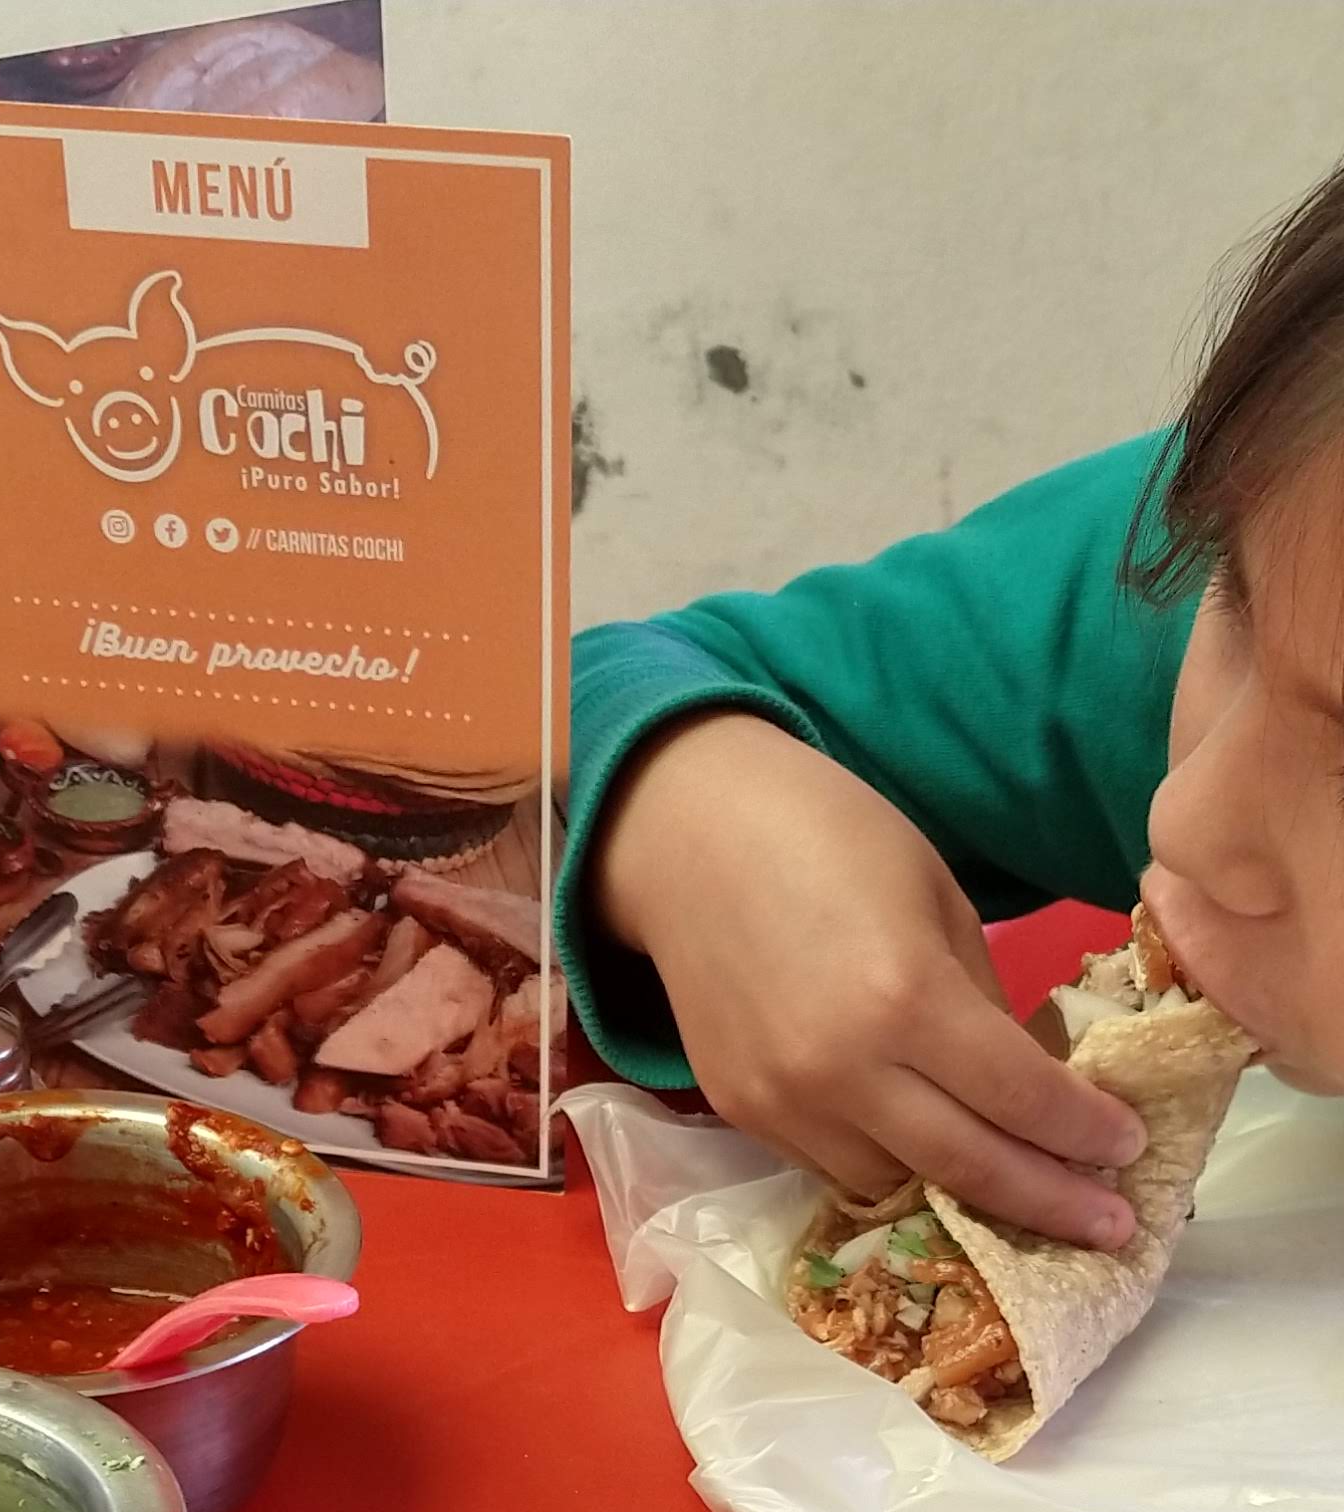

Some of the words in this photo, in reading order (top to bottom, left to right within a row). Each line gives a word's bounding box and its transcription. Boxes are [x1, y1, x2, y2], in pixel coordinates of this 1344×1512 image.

[152, 157, 293, 222] MENÚ
[236, 384, 305, 412] Carnitas
[199, 387, 365, 473] Cochi
[240, 466, 307, 491] ¡Puro
[319, 471, 400, 500] Sabor!
[265, 529, 349, 558] CARNITAS
[352, 536, 405, 562] COCHI
[79, 618, 198, 664] ¡Buen
[205, 641, 420, 684] provecho!
